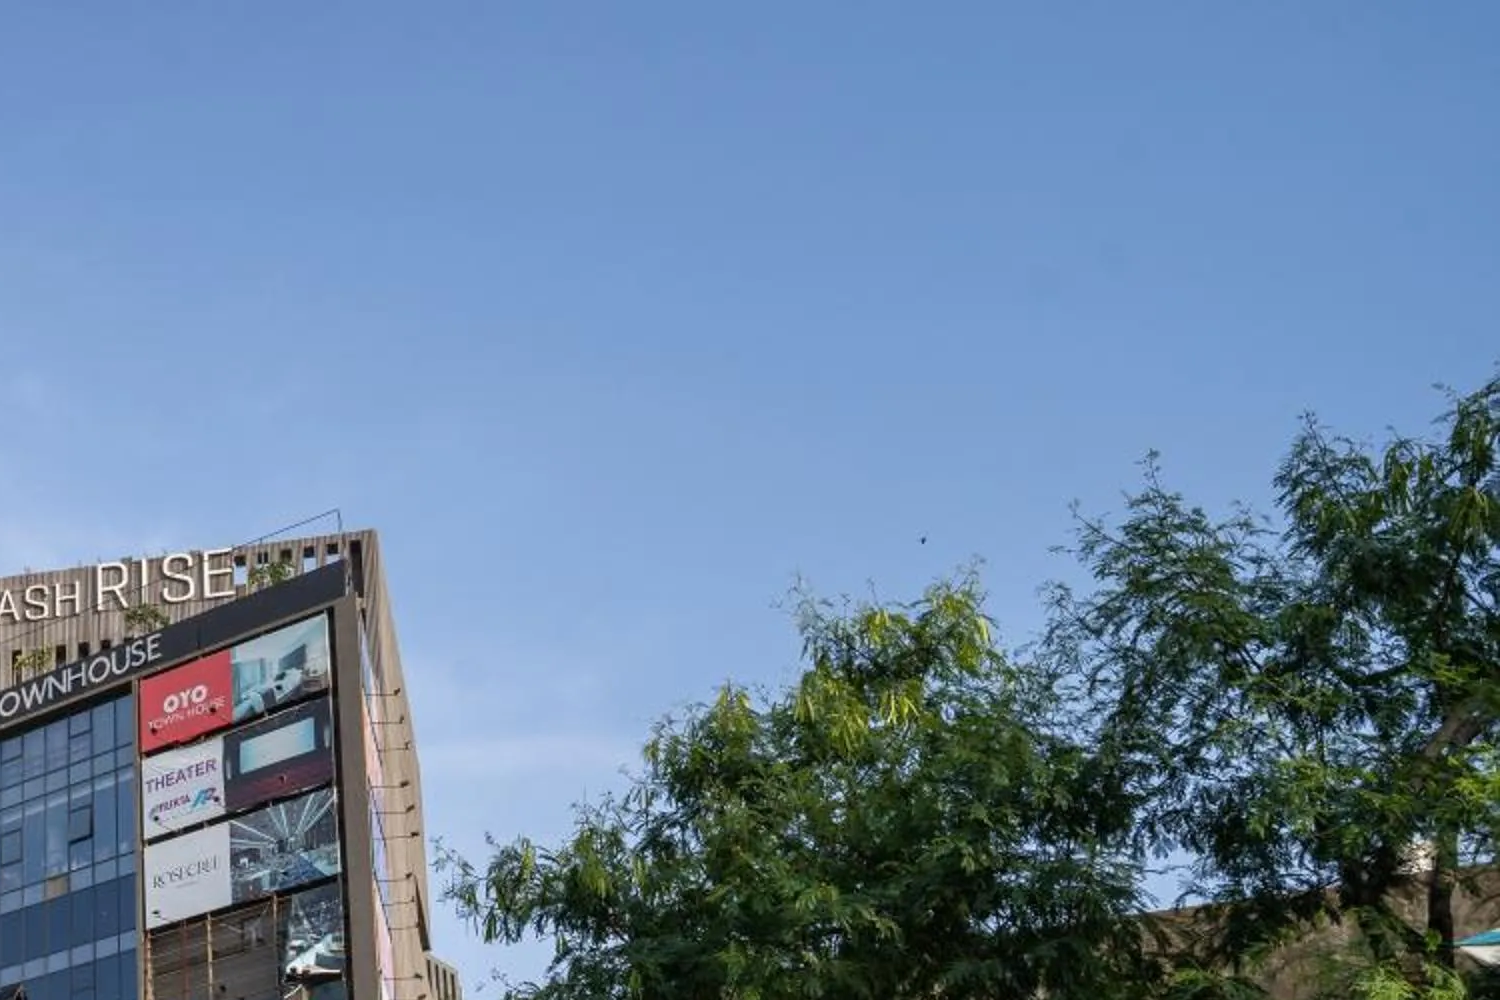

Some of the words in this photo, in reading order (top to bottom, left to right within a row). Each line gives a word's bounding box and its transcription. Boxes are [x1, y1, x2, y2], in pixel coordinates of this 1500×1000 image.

[97, 547, 236, 611] RISE
[163, 684, 208, 714] OYO
[145, 757, 218, 793] THEATER
